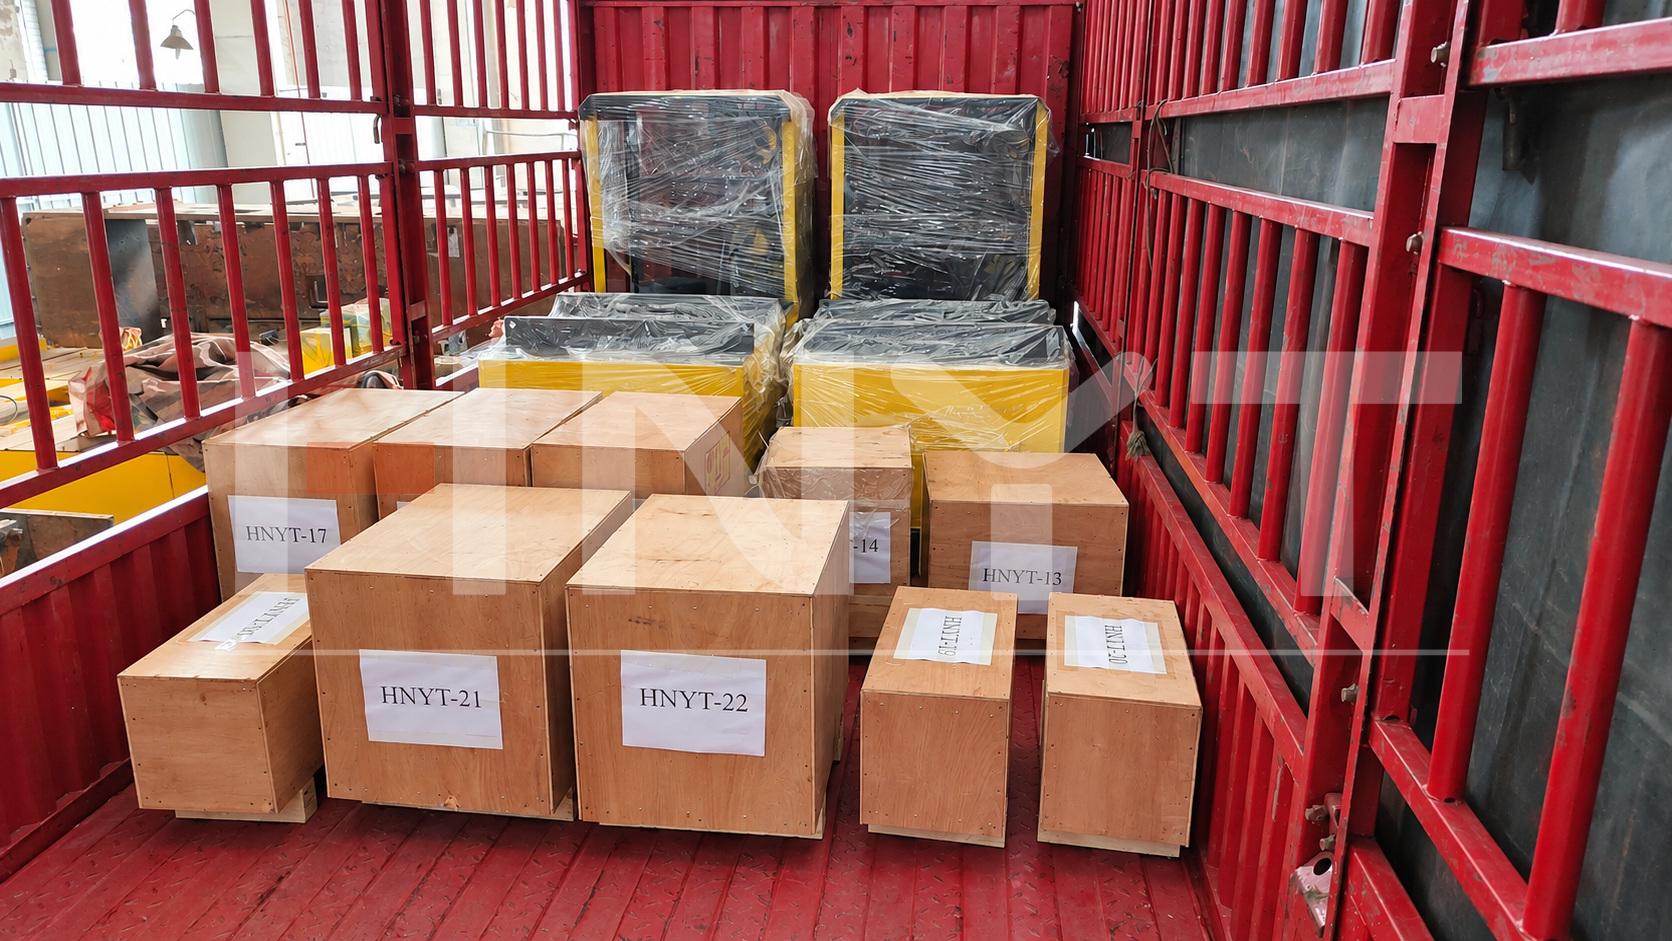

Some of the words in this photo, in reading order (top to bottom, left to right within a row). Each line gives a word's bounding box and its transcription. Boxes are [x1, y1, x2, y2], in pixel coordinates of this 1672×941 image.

[245, 524, 328, 544] HNYT-17
[983, 567, 1062, 586] HNYT-13
[937, 615, 962, 657] HNYT-19
[380, 685, 482, 709] HNYT-21
[639, 686, 749, 713] HNYT-22
